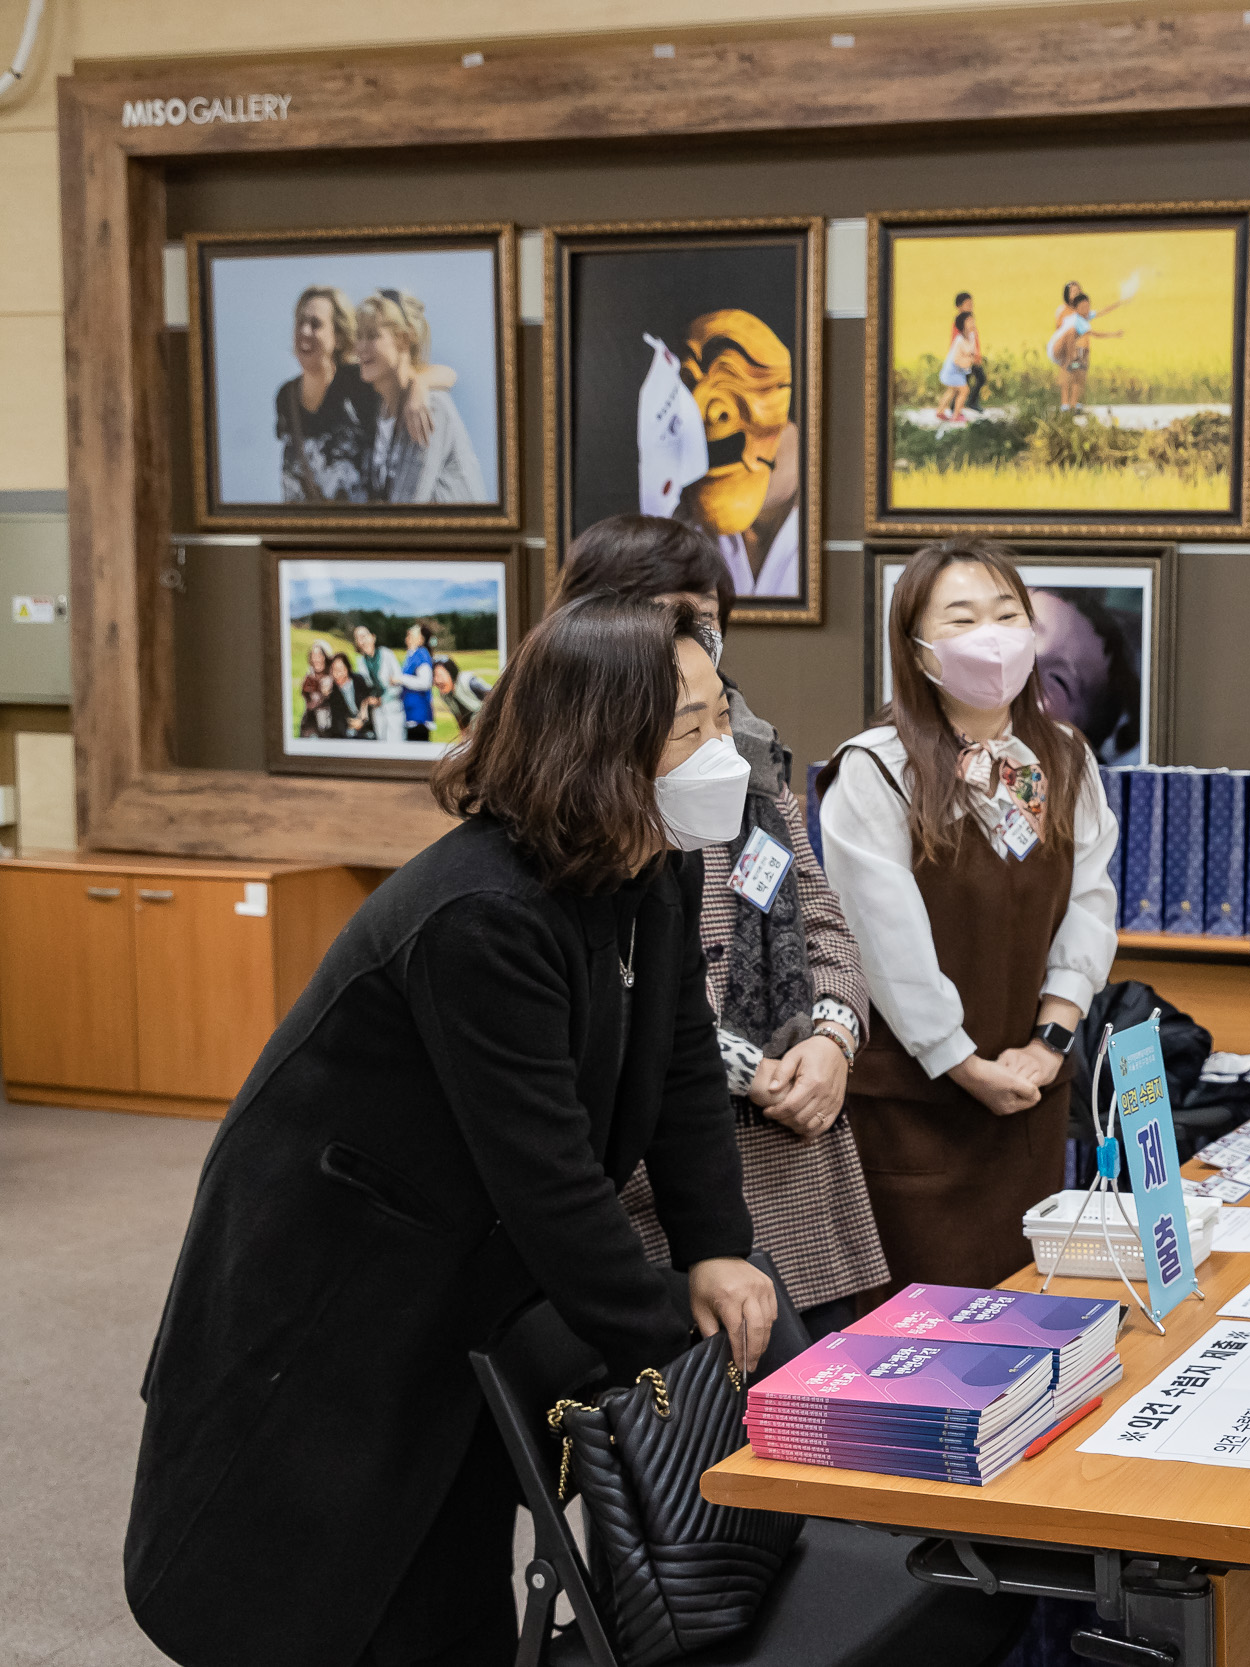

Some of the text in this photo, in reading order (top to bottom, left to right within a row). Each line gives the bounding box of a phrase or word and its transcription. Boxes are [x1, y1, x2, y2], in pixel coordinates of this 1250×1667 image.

[1121, 1076, 1164, 1117] 의견 수렴지
[805, 1363, 848, 1386] 한반도
[819, 1371, 862, 1394] 통일과
[1161, 1365, 1222, 1398] 수렴지
[1213, 1434, 1248, 1454] 의견
